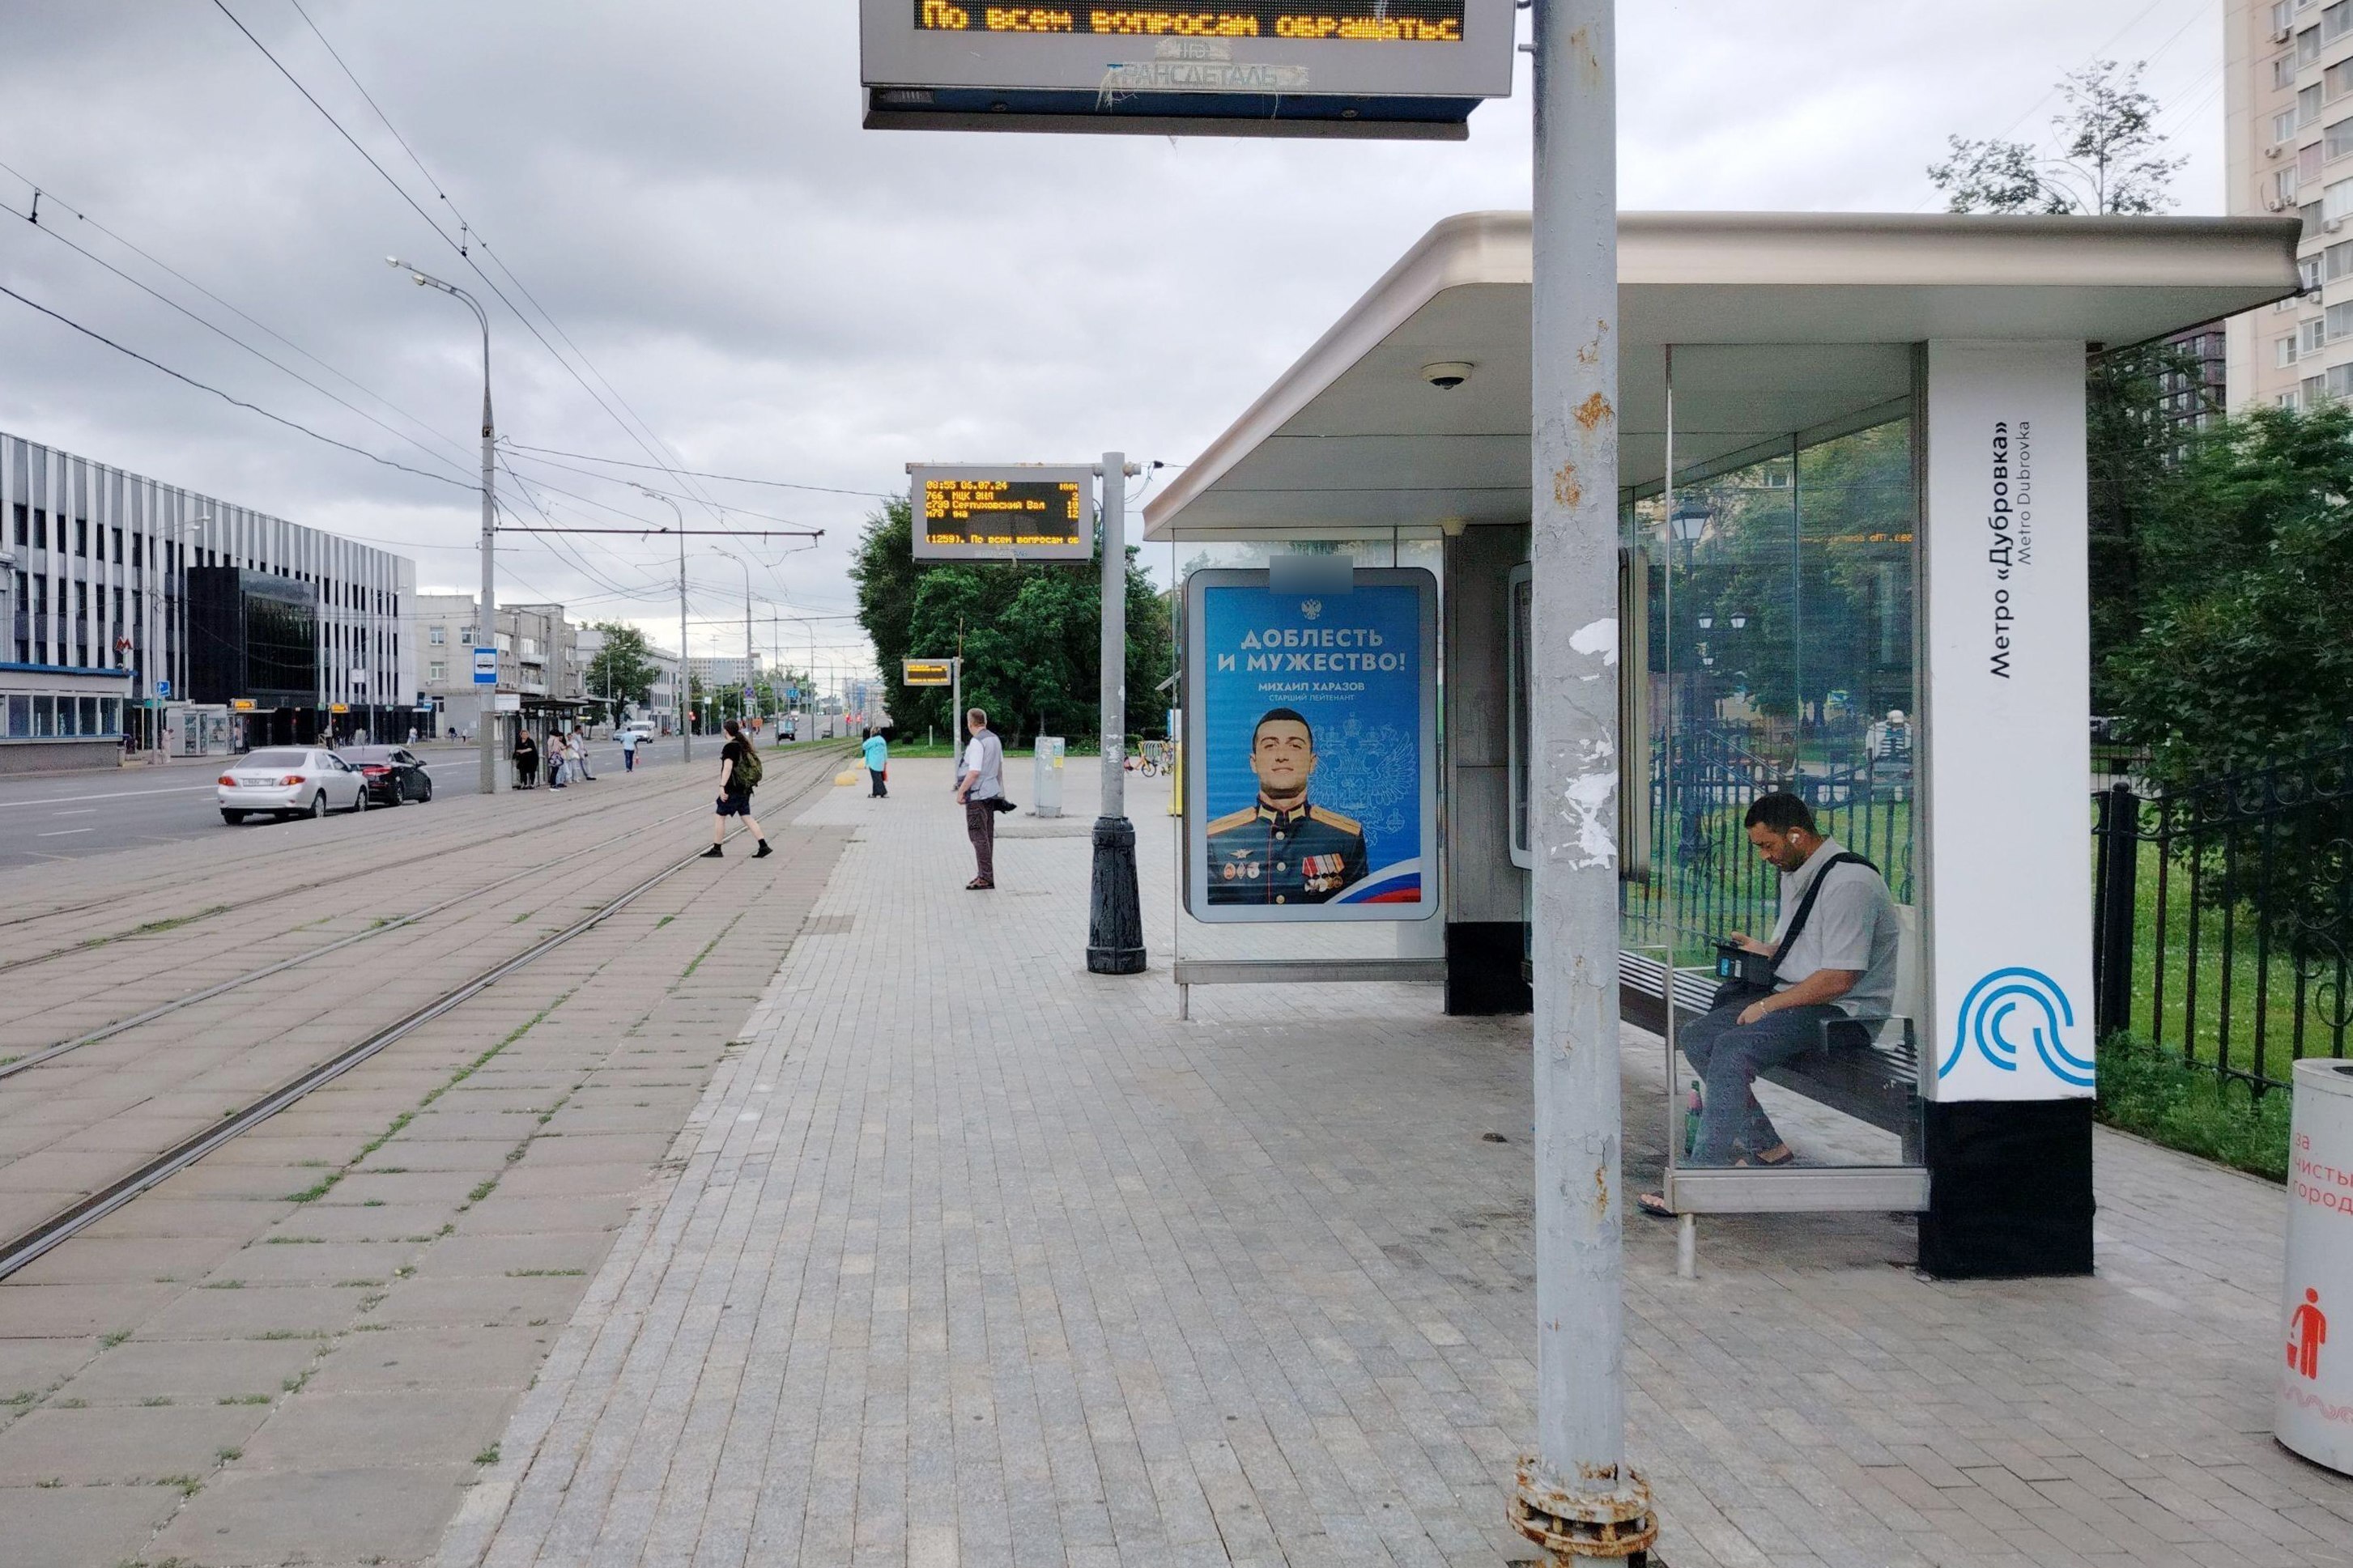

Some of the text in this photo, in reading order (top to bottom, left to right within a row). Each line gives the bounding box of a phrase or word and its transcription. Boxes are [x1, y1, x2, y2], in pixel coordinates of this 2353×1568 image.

[921, 0, 968, 29] По
[985, 6, 1072, 32] всем
[1090, 9, 1260, 37] вопросам
[925, 491, 944, 500] 766
[2015, 421, 2032, 565] Metro Dubrovka
[1026, 500, 1046, 510] Вал
[970, 534, 984, 544] По
[988, 536, 1012, 544] всем
[1016, 536, 1064, 544] вопросам
[1988, 421, 2015, 679] Метро «Дубровка»
[1240, 628, 1383, 650] ДОБЛЕСТЬ
[1217, 652, 1406, 672] И МУЖЕСТВО!
[1258, 682, 1366, 692] МИХАИЛ ХАРАЗОВ
[1269, 694, 1355, 702] СТАРШИЙ ЛЕЙТЕНАНТ
[2295, 1132, 2310, 1150] за
[2292, 1179, 2353, 1216] город
